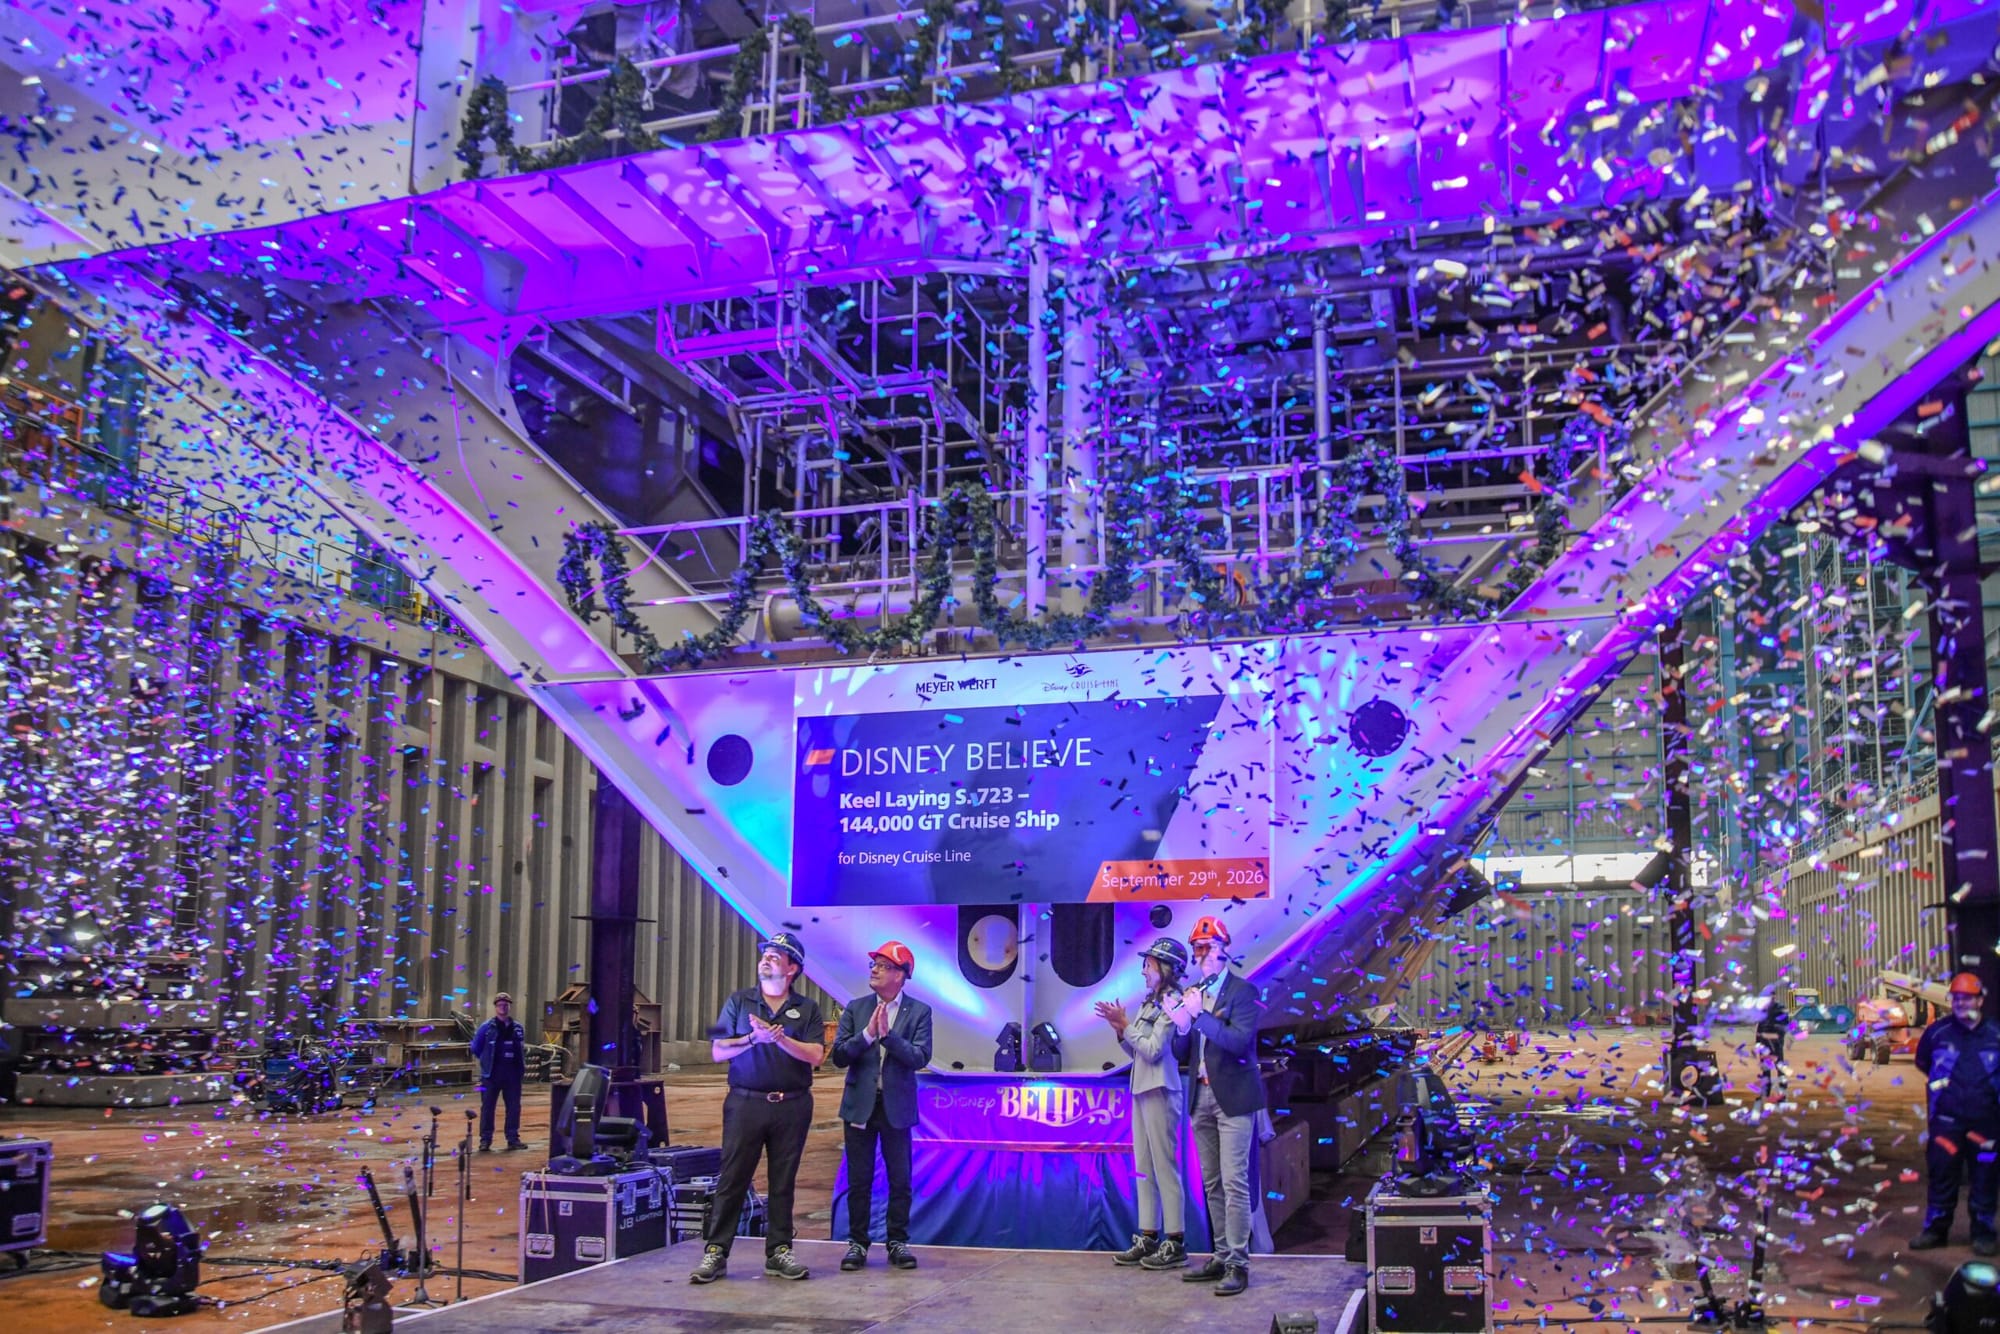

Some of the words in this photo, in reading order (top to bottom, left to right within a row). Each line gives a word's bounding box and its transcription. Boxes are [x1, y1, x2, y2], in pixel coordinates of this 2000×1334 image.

[916, 680, 954, 694] MEYER
[957, 678, 997, 690] WERFT
[1071, 679, 1098, 690] CRUISE
[841, 744, 955, 776] DISNEY
[966, 738, 1092, 771] BELIEVE
[839, 791, 881, 809] Keel
[885, 789, 950, 811] Laying
[839, 815, 914, 834] 144,000
[918, 813, 944, 831] GT
[948, 811, 1011, 830] Cruise
[1015, 810, 1060, 832] Ship
[838, 851, 856, 865] for
[859, 851, 900, 866] Disney
[902, 849, 942, 864] Cruise
[945, 849, 972, 863] Line
[1226, 869, 1264, 885] 2026
[996, 1086, 1126, 1127] BELIEVE
